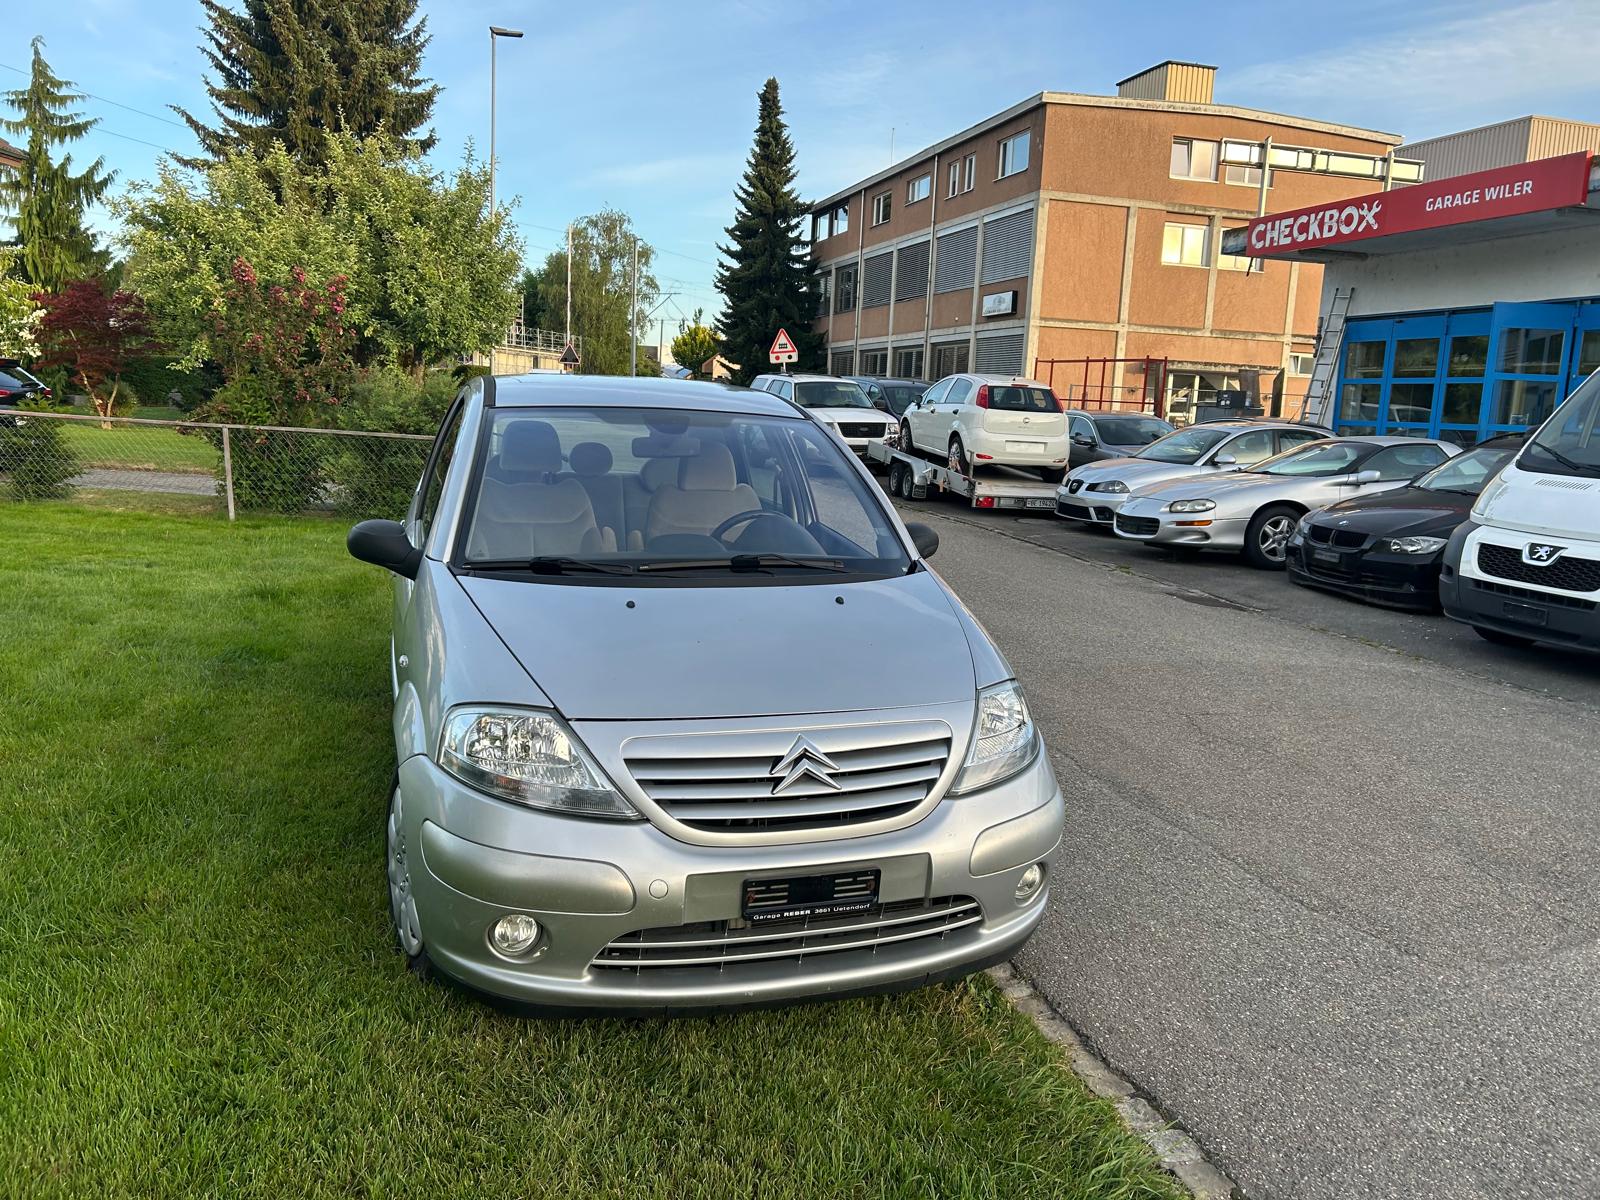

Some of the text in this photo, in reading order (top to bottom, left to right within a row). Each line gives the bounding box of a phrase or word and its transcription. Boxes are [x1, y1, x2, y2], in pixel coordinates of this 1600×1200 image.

[1425, 180, 1533, 212] GARAGE WILER
[1251, 200, 1382, 249] CHECKBOX
[783, 909, 811, 917] REBER
[833, 903, 871, 912] Uetendorf
